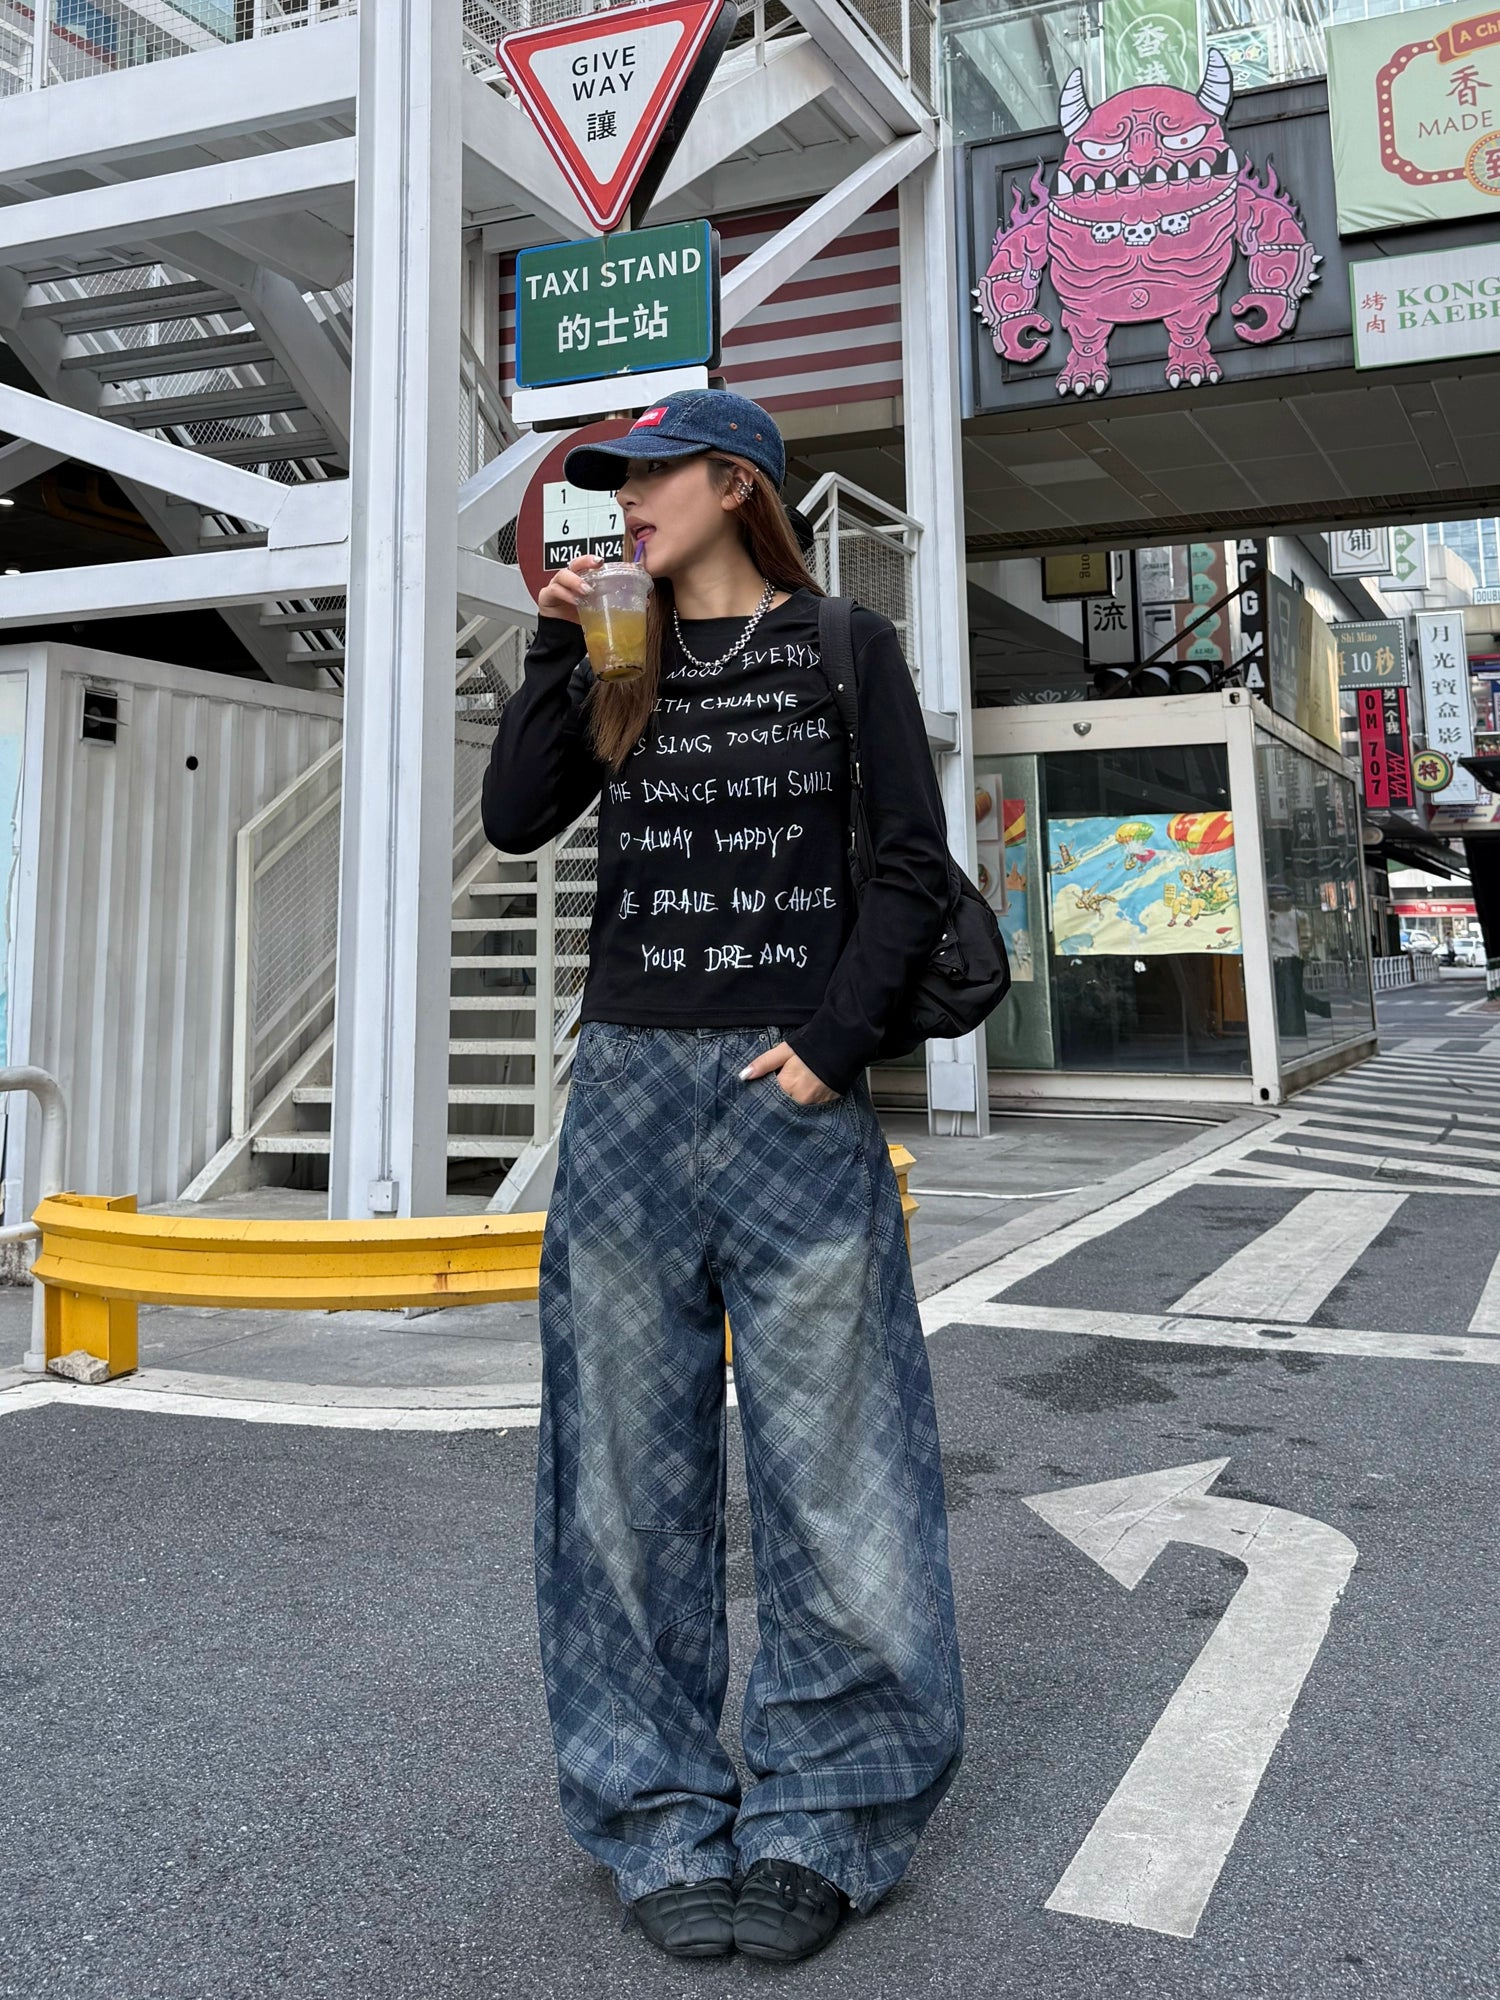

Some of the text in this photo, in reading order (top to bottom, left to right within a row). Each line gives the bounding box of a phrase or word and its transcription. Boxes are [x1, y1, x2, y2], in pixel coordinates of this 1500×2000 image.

[1460, 29, 1472, 44] A
[572, 46, 636, 76] GIVE
[573, 71, 634, 101] WAY
[1446, 65, 1493, 107] 香
[586, 110, 617, 142] 讓
[1418, 110, 1493, 138] MADE
[526, 248, 702, 300] TAXI STAND
[1396, 276, 1500, 308] KONG
[558, 300, 669, 353] 的士站
[1361, 291, 1387, 333] 烤肉
[561, 488, 566, 505] 1
[562, 513, 617, 535] 6 7
[550, 540, 625, 563] N216 N24
[1341, 631, 1355, 643] Shi
[1357, 631, 1378, 643] Miao
[741, 644, 822, 671] EVERYD
[1241, 631, 1265, 704] MA
[652, 691, 799, 714] ITH CHUANYE
[1384, 688, 1400, 735] 另一个我
[656, 734, 713, 755] SING
[726, 717, 831, 747] TOGETHER
[1368, 741, 1381, 795] 707
[608, 780, 632, 805] THE
[641, 778, 718, 804] DANCE
[727, 775, 777, 798] WITH
[633, 825, 785, 859] ALWAY HAPPY
[651, 888, 719, 916] BRAVE
[730, 887, 766, 914] AND
[641, 944, 687, 972] YOUR
